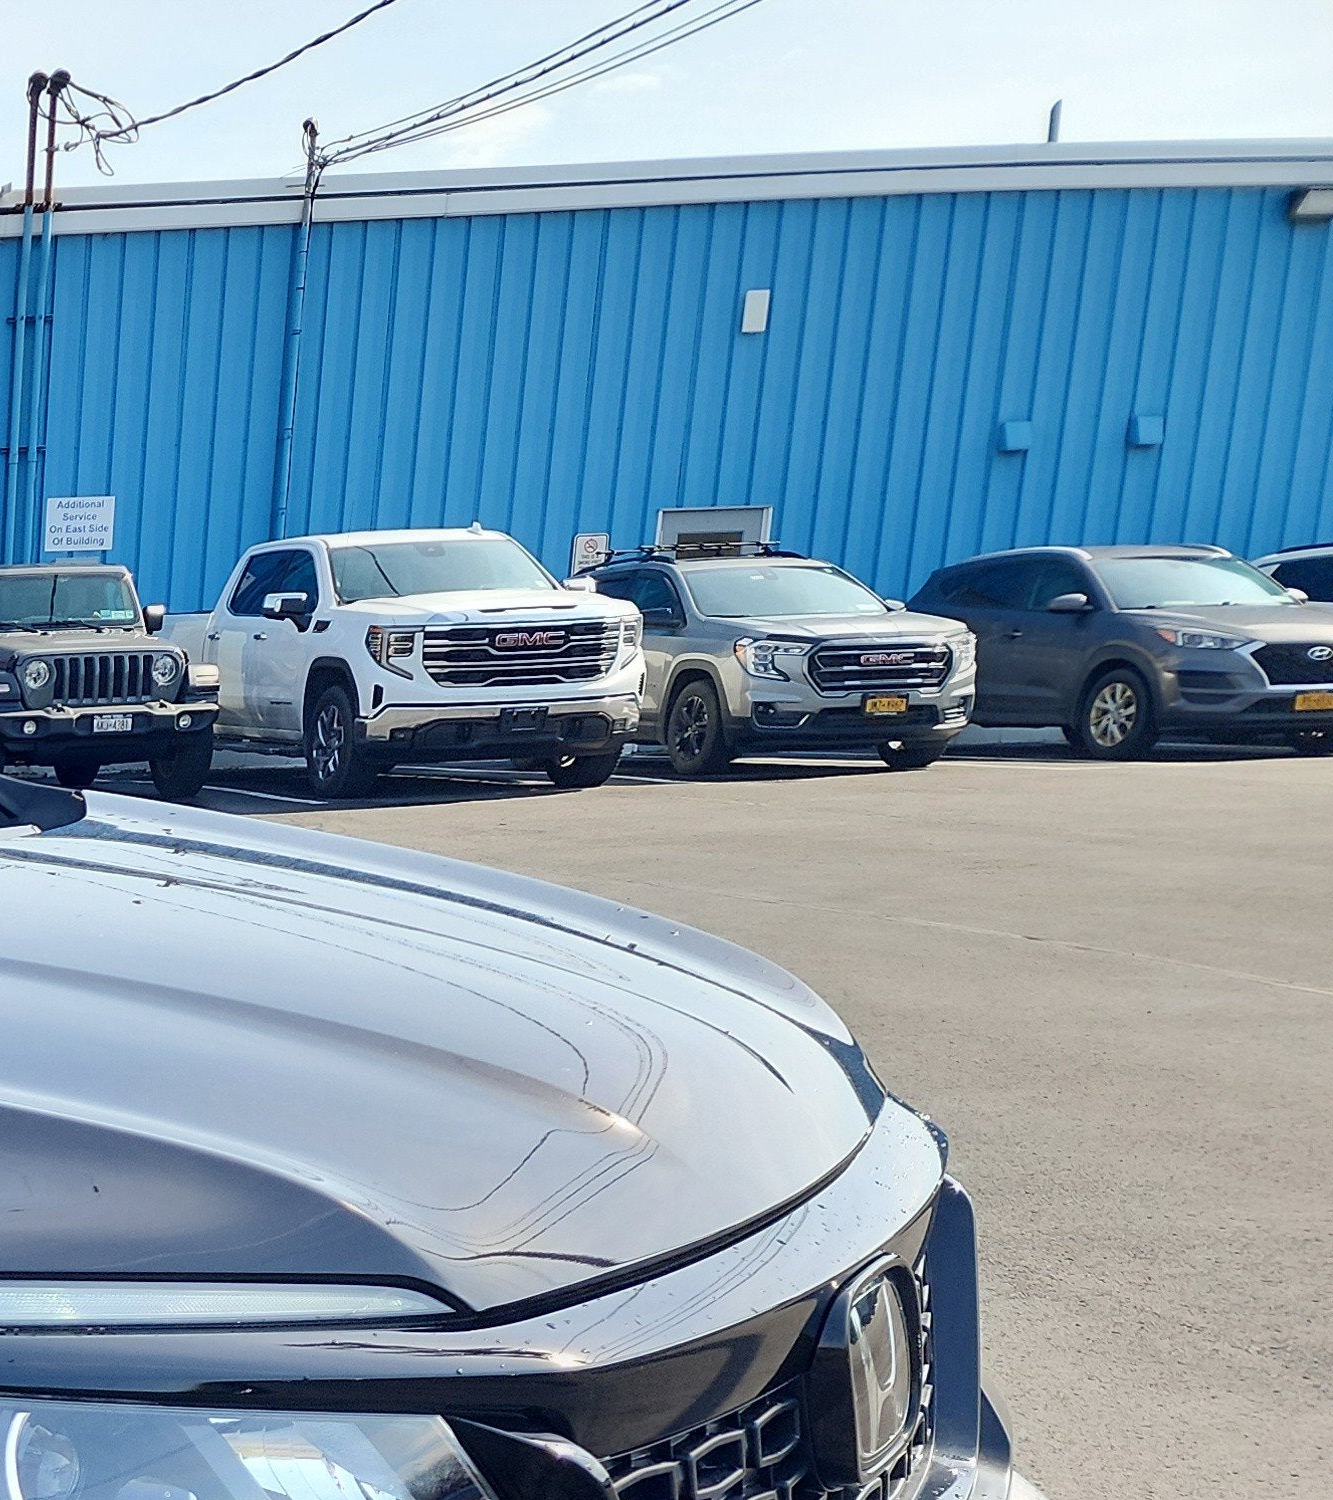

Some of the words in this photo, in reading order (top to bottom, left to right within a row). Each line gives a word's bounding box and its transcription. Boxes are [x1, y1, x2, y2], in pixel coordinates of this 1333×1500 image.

[56, 500, 104, 509] Additional
[62, 512, 97, 521] Service
[49, 524, 62, 534] On
[65, 524, 86, 534] East
[88, 523, 109, 533] Side
[52, 537, 64, 546] Of
[66, 536, 104, 547] Building
[495, 631, 565, 647] GMC
[860, 653, 915, 665] GMC
